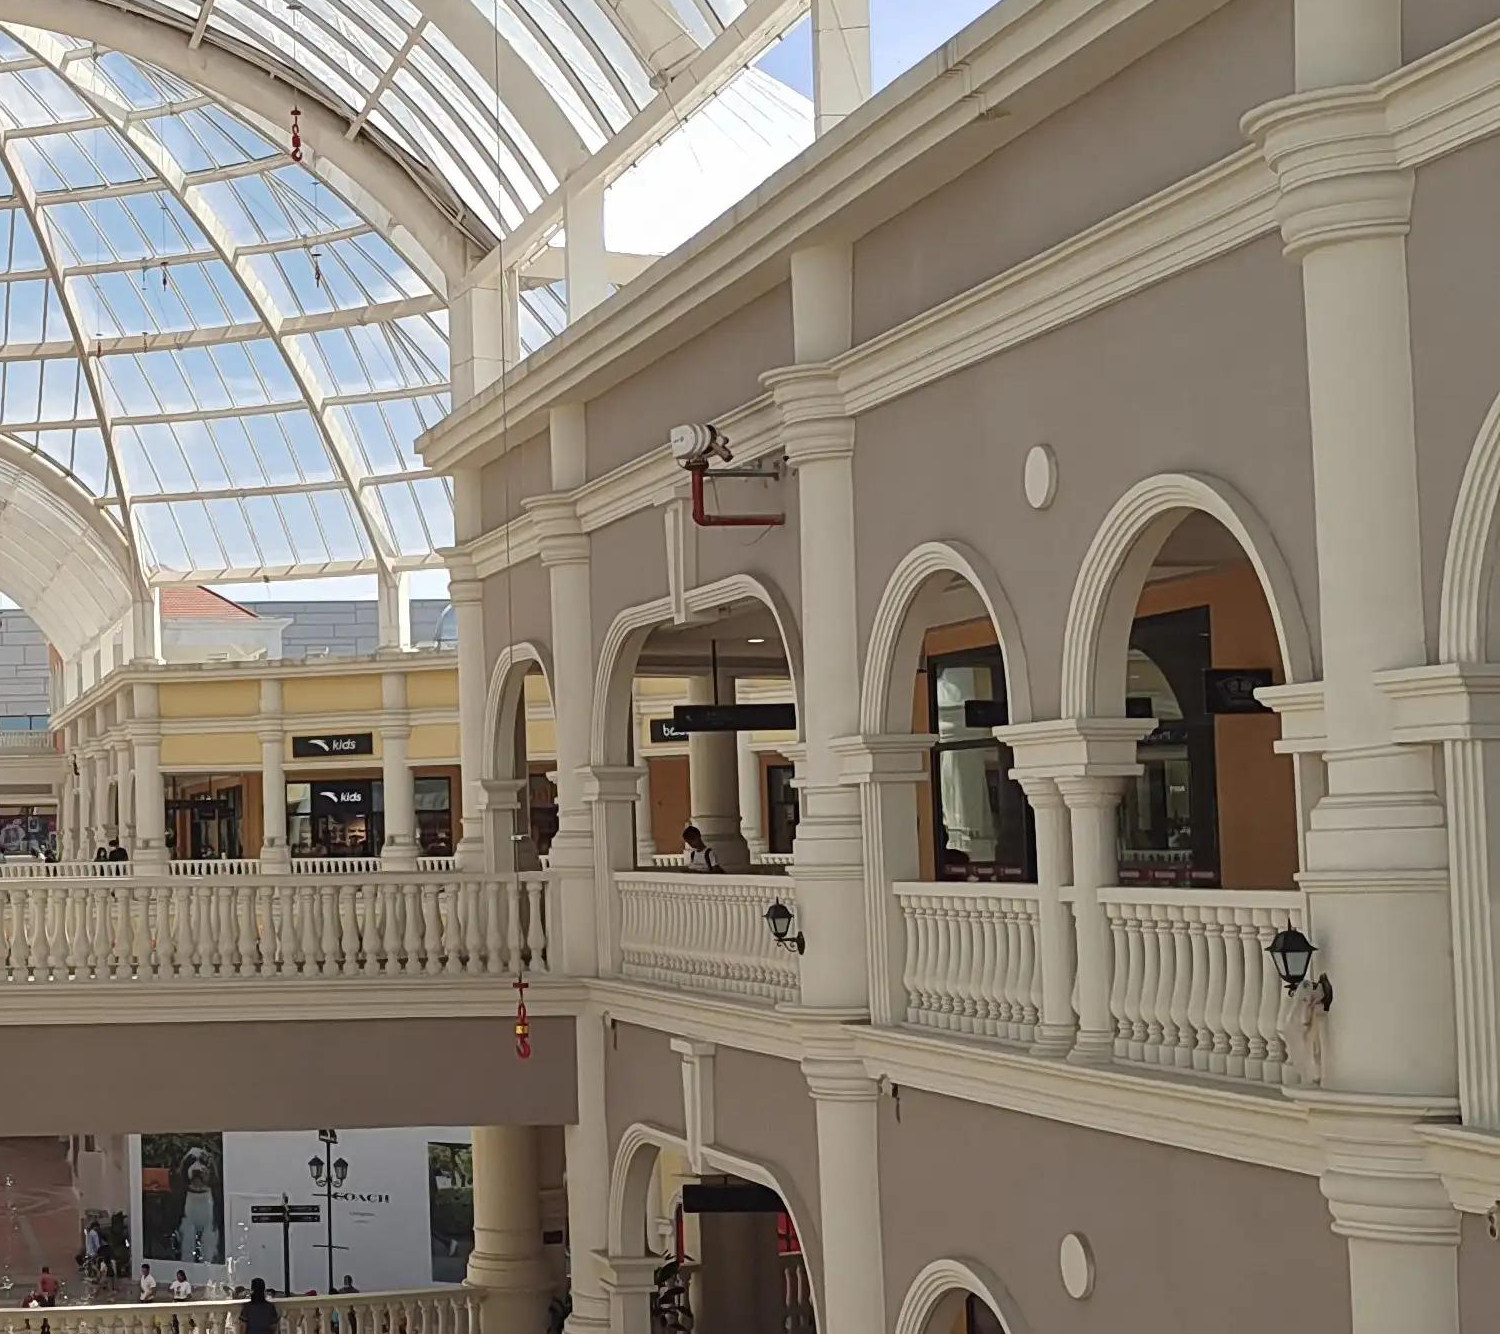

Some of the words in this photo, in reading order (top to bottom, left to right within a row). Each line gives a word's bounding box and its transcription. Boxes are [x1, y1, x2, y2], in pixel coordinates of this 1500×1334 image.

[332, 738, 357, 750] kids
[340, 792, 362, 803] kids
[331, 1191, 389, 1204] COACH
